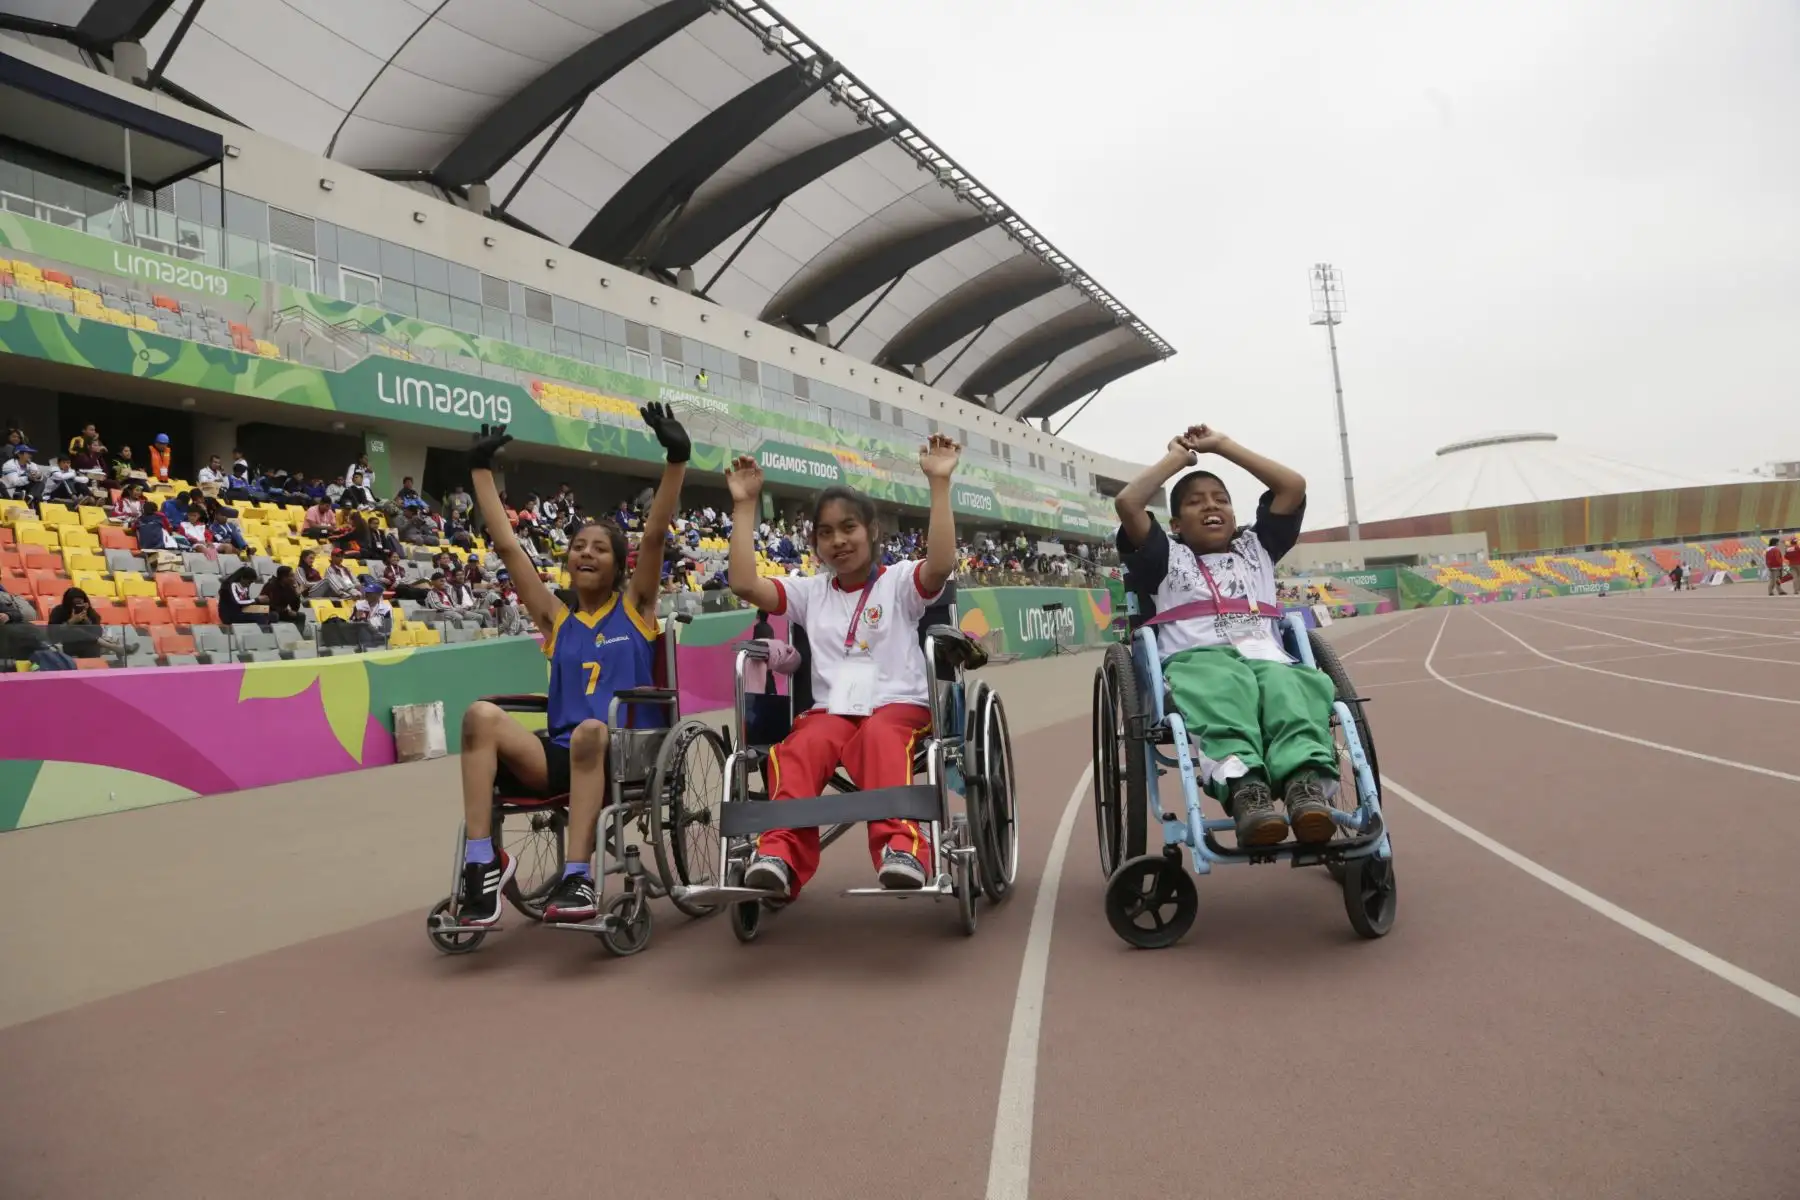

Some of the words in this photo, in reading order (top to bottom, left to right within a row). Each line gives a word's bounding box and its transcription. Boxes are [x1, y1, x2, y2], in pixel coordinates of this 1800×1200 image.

[113, 250, 228, 295] Lima2019
[377, 372, 512, 424] Lima2019
[761, 451, 807, 474] JUGAMOS
[808, 461, 838, 480] TODOS
[582, 661, 601, 695] 7
